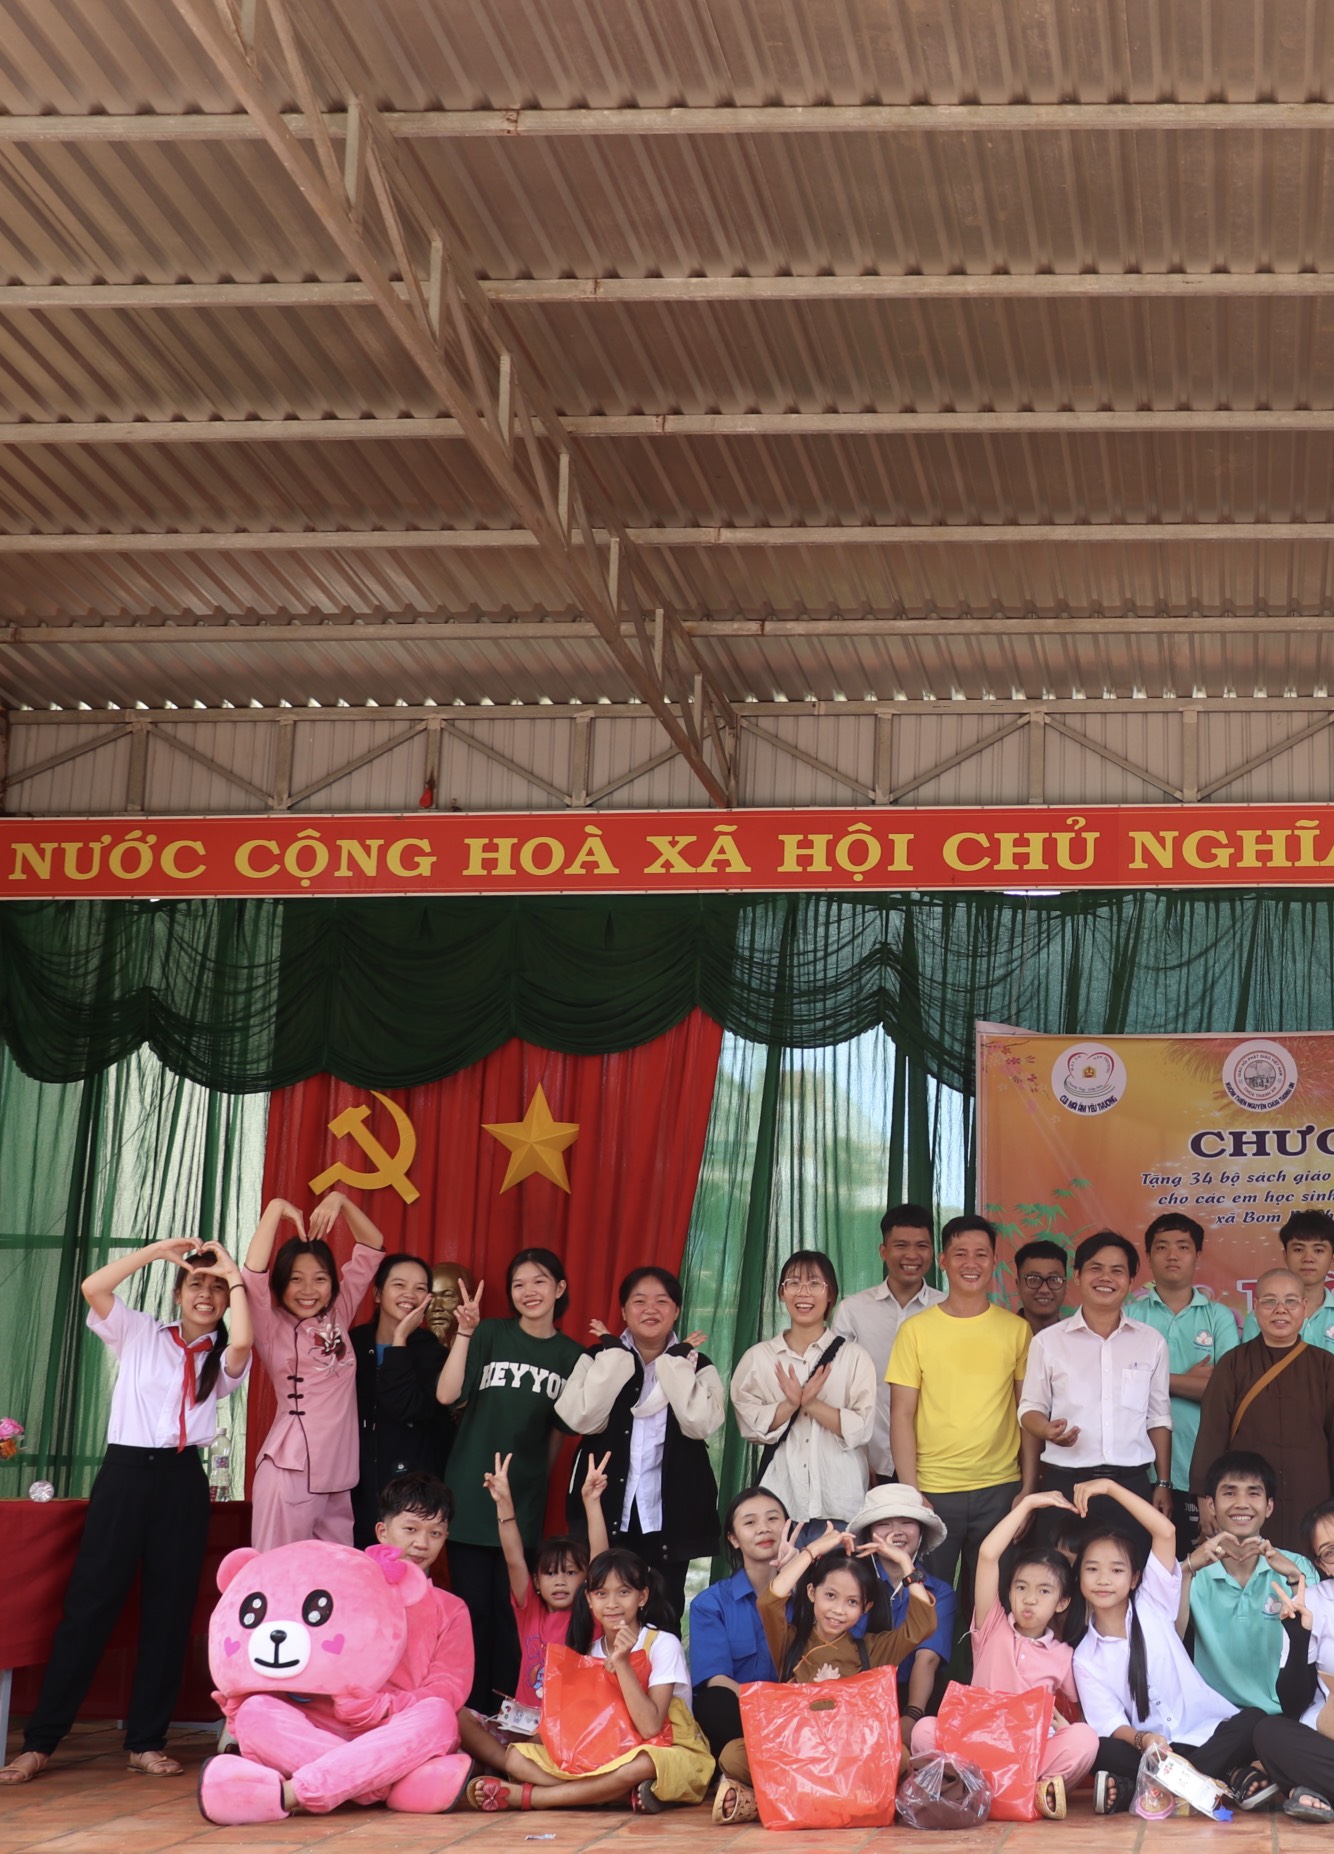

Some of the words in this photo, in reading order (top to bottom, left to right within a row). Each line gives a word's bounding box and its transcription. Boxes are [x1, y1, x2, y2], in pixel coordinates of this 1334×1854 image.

[8, 831, 206, 880] NƯỚC
[234, 828, 437, 887] CỘNG
[462, 825, 619, 876] HOÀ
[644, 823, 751, 875] XÃ
[777, 822, 915, 881] HỘI
[942, 816, 1100, 873] CHỦ
[1141, 1173, 1182, 1188] Tặng
[1190, 1172, 1213, 1185] 34
[1220, 1171, 1240, 1186] bộ
[1246, 1170, 1286, 1183] sách
[1293, 1170, 1331, 1185] giáo
[1158, 1193, 1188, 1205] cho
[1195, 1193, 1225, 1204] các
[1232, 1194, 1257, 1203] em
[1264, 1190, 1294, 1205] học
[1215, 1212, 1236, 1224] xã
[1242, 1211, 1281, 1223] Bom
